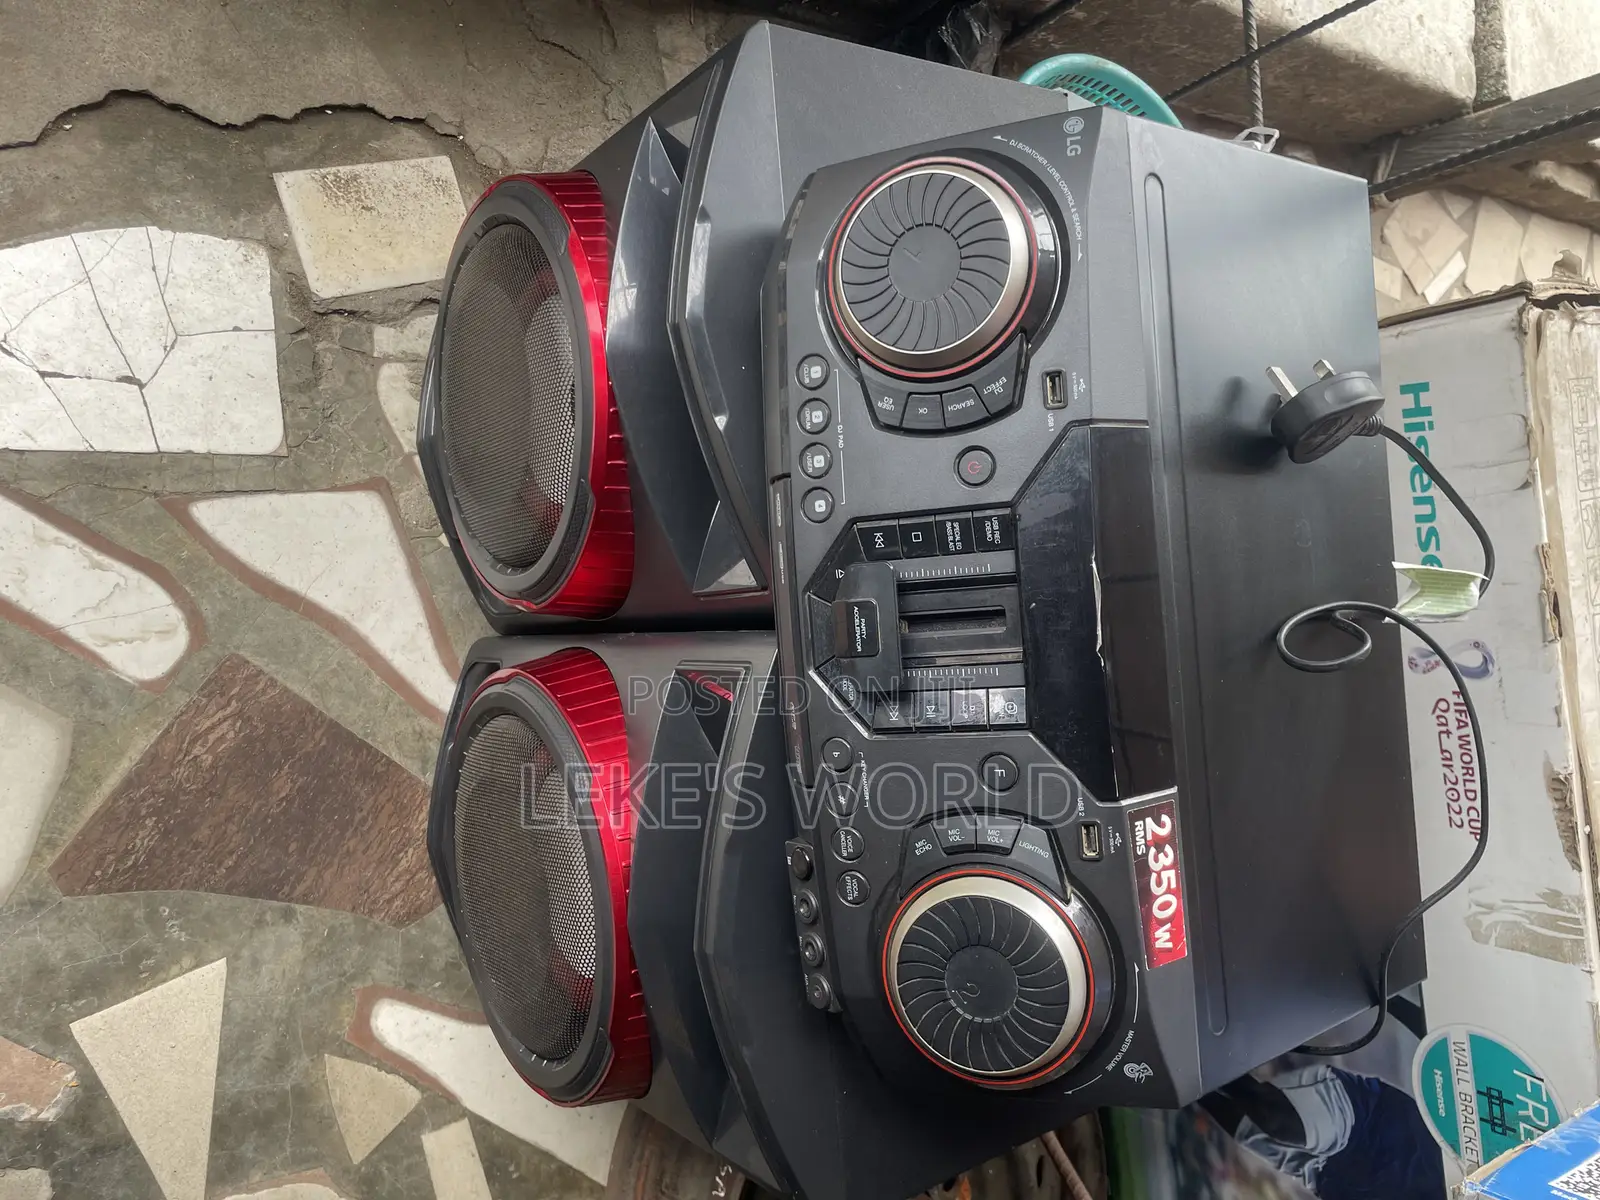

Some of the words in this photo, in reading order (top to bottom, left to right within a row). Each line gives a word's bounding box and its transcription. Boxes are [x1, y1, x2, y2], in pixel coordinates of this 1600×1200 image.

[1067, 136, 1081, 157] LG
[1017, 144, 1048, 166] SCRATCHER
[1046, 165, 1061, 182] LEVEL
[1058, 181, 1075, 208] CONTROL
[1072, 213, 1083, 240] SEARCH
[982, 376, 1007, 395] EFFECT
[993, 386, 1004, 396] DJ
[877, 401, 895, 411] USER
[883, 396, 894, 405] EQ
[947, 398, 975, 412] SEARCH
[917, 407, 928, 415] OK
[837, 425, 843, 433] DJ
[945, 521, 954, 536] /BASS
[952, 521, 961, 542] SPECIAL
[984, 520, 993, 542] /DEMO
[991, 517, 999, 530] USB
[947, 535, 956, 551] BLAST
[955, 541, 962, 550] EQ
[993, 530, 1001, 545] REC
[853, 605, 862, 652] ACCELERATOR
[1451, 690, 1469, 730] FIFA
[1457, 734, 1478, 802] WORLD
[948, 828, 961, 836] MIC
[987, 829, 1001, 837] MIC
[1466, 806, 1482, 842] CUP
[840, 830, 848, 857] CANCELLER
[915, 838, 928, 848] MIC
[986, 835, 1004, 844] VOL+
[1134, 820, 1146, 856] RMS
[914, 843, 932, 856] ECHO
[1018, 840, 1049, 858] LIGHTING
[845, 876, 853, 901] EFFECTS
[851, 878, 859, 898] VOCAL
[1154, 922, 1173, 949] W
[1119, 1029, 1135, 1053] MASTER
[1104, 1051, 1124, 1072] VOLUME
[1452, 1040, 1471, 1086] WALL
[1433, 1068, 1446, 1117] Hisense
[1512, 1069, 1549, 1142] FRE
[1458, 1092, 1480, 1169] BRACKET
